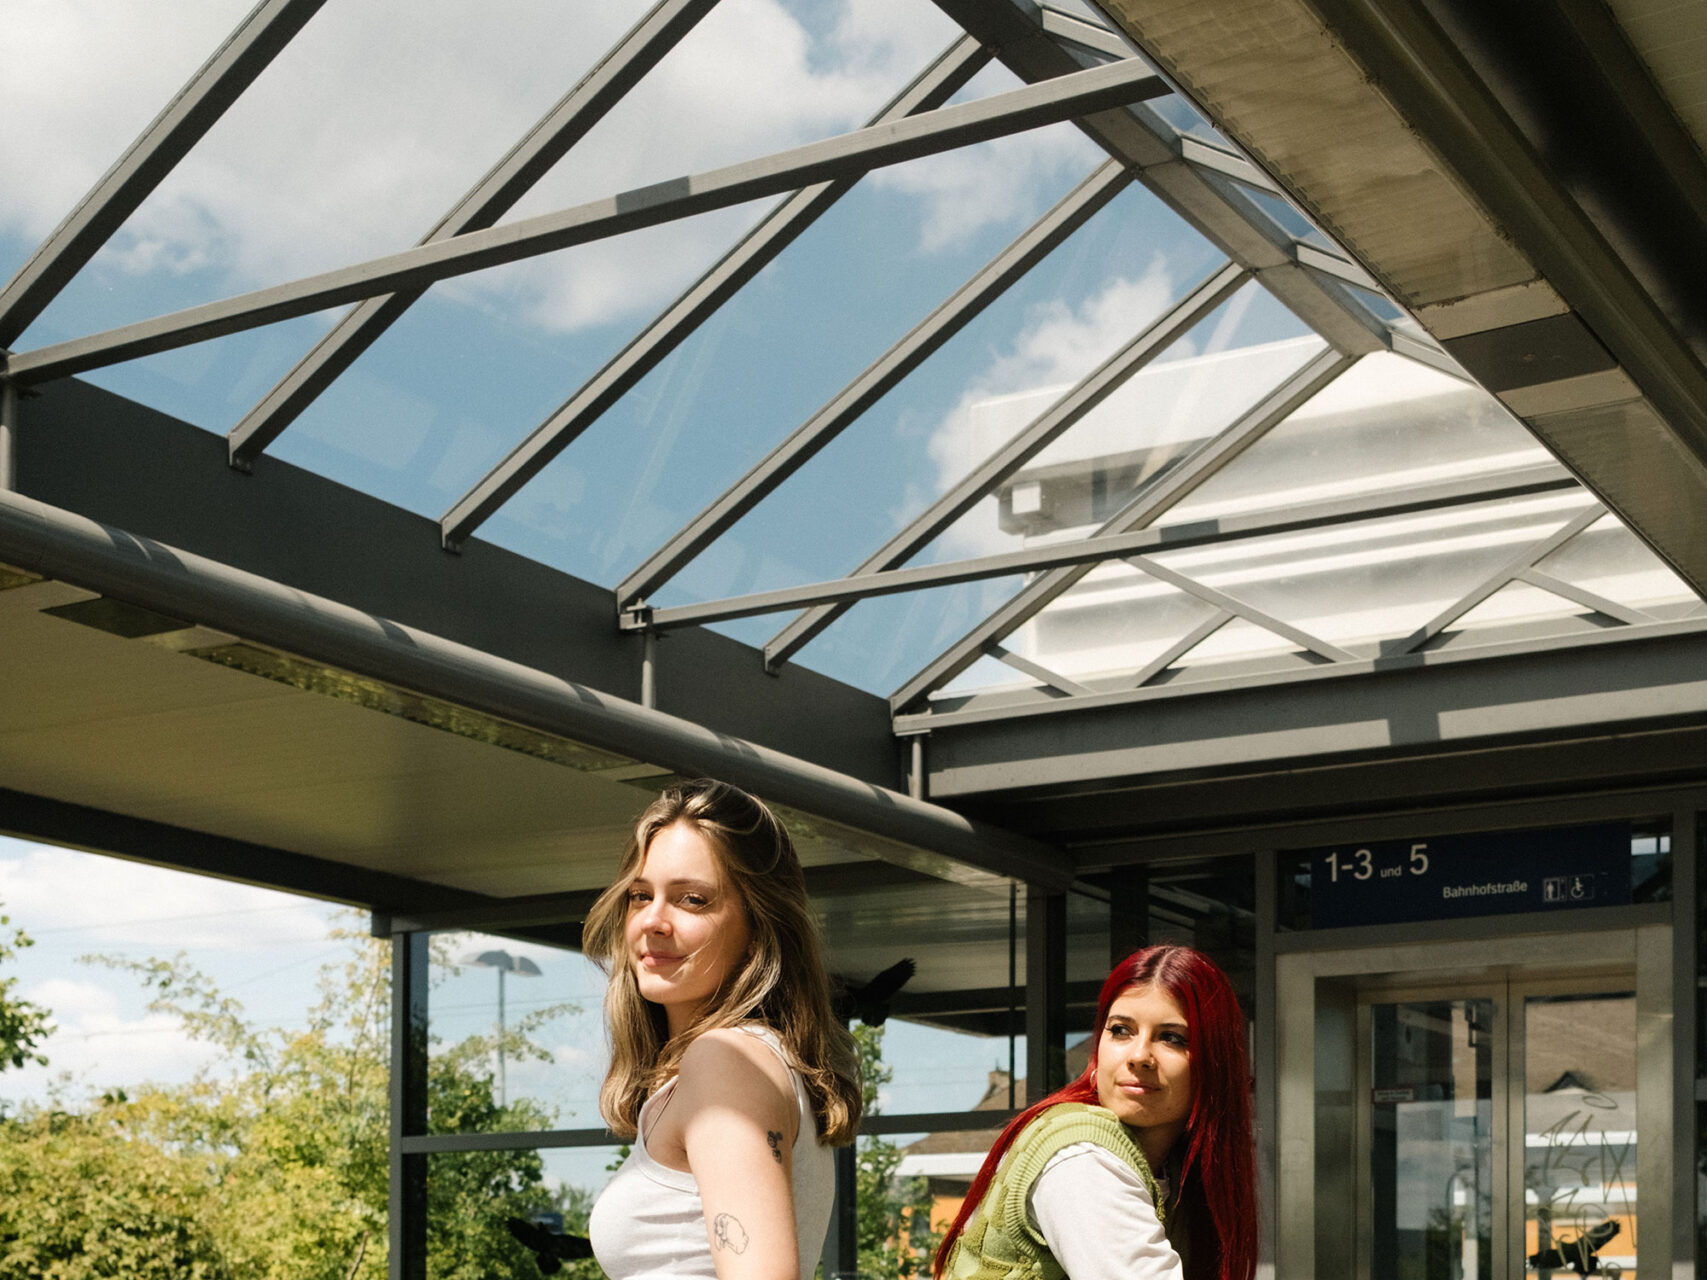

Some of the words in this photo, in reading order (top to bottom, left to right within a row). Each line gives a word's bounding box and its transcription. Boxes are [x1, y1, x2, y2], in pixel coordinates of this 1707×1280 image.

[1325, 849, 1373, 882] 1-3
[1380, 865, 1402, 878] und
[1409, 843, 1429, 875] 5
[1443, 880, 1528, 898] Bahnhofstraße
